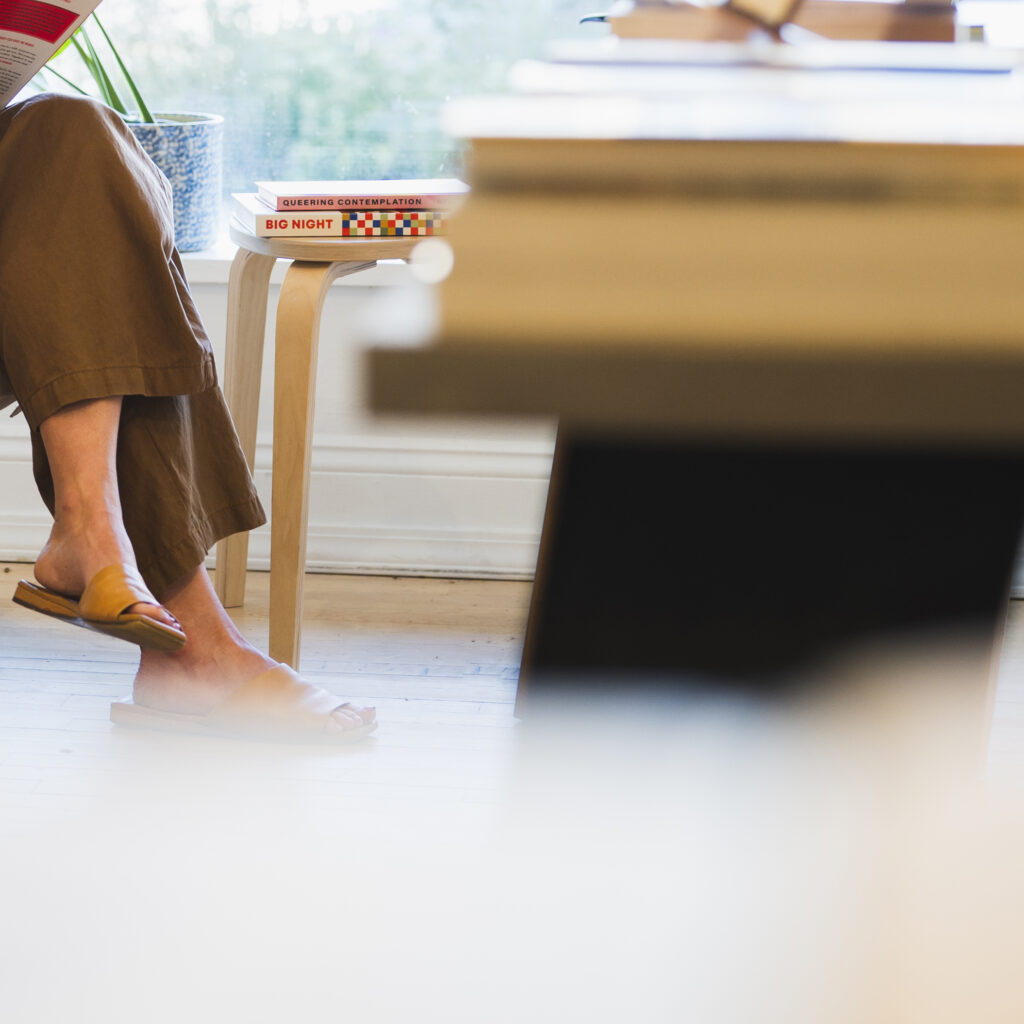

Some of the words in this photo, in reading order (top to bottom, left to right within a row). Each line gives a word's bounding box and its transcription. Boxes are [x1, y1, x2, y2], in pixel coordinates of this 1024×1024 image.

[282, 198, 334, 207] QUEERING
[337, 198, 423, 206] CONTEMPLATION
[265, 219, 288, 230] BIG
[291, 219, 334, 230] NIGHT
